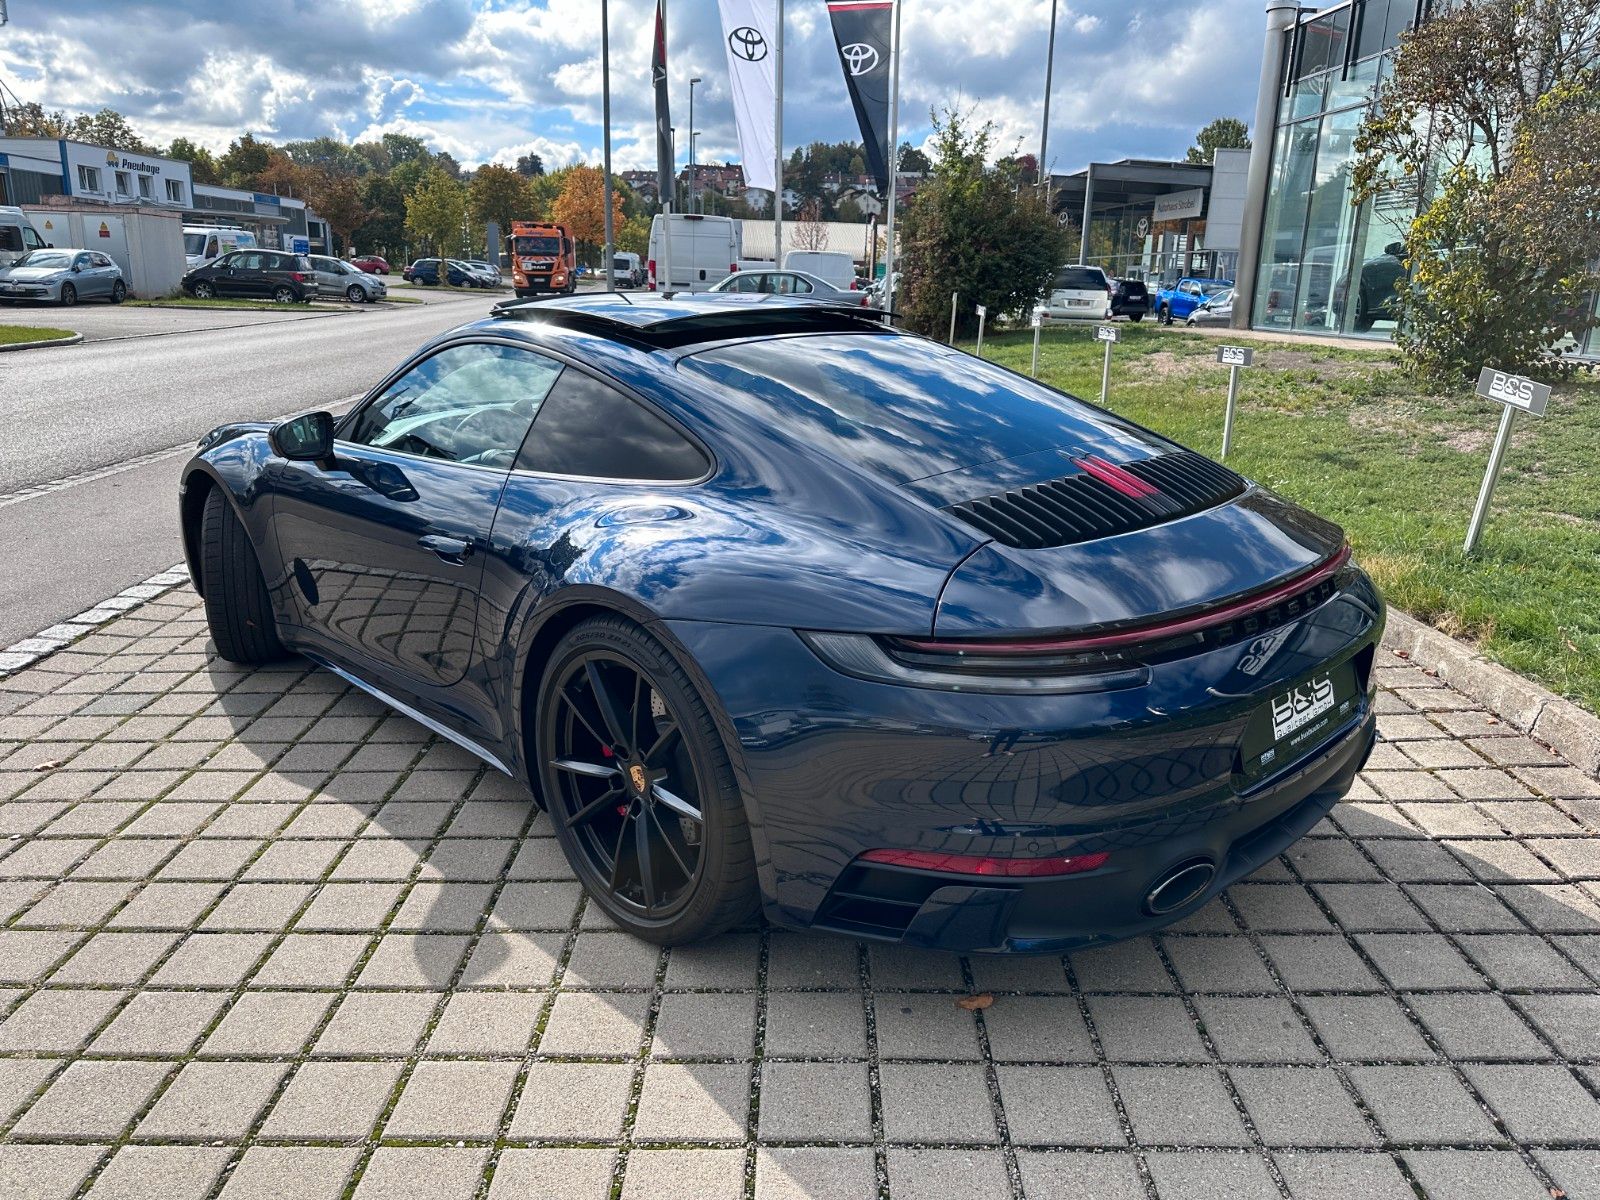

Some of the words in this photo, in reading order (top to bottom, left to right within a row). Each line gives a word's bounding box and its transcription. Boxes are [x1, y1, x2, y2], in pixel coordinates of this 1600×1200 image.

[122, 159, 160, 175] Pneuhage
[1489, 373, 1533, 403] B&S
[1216, 582, 1330, 641] PORSCH
